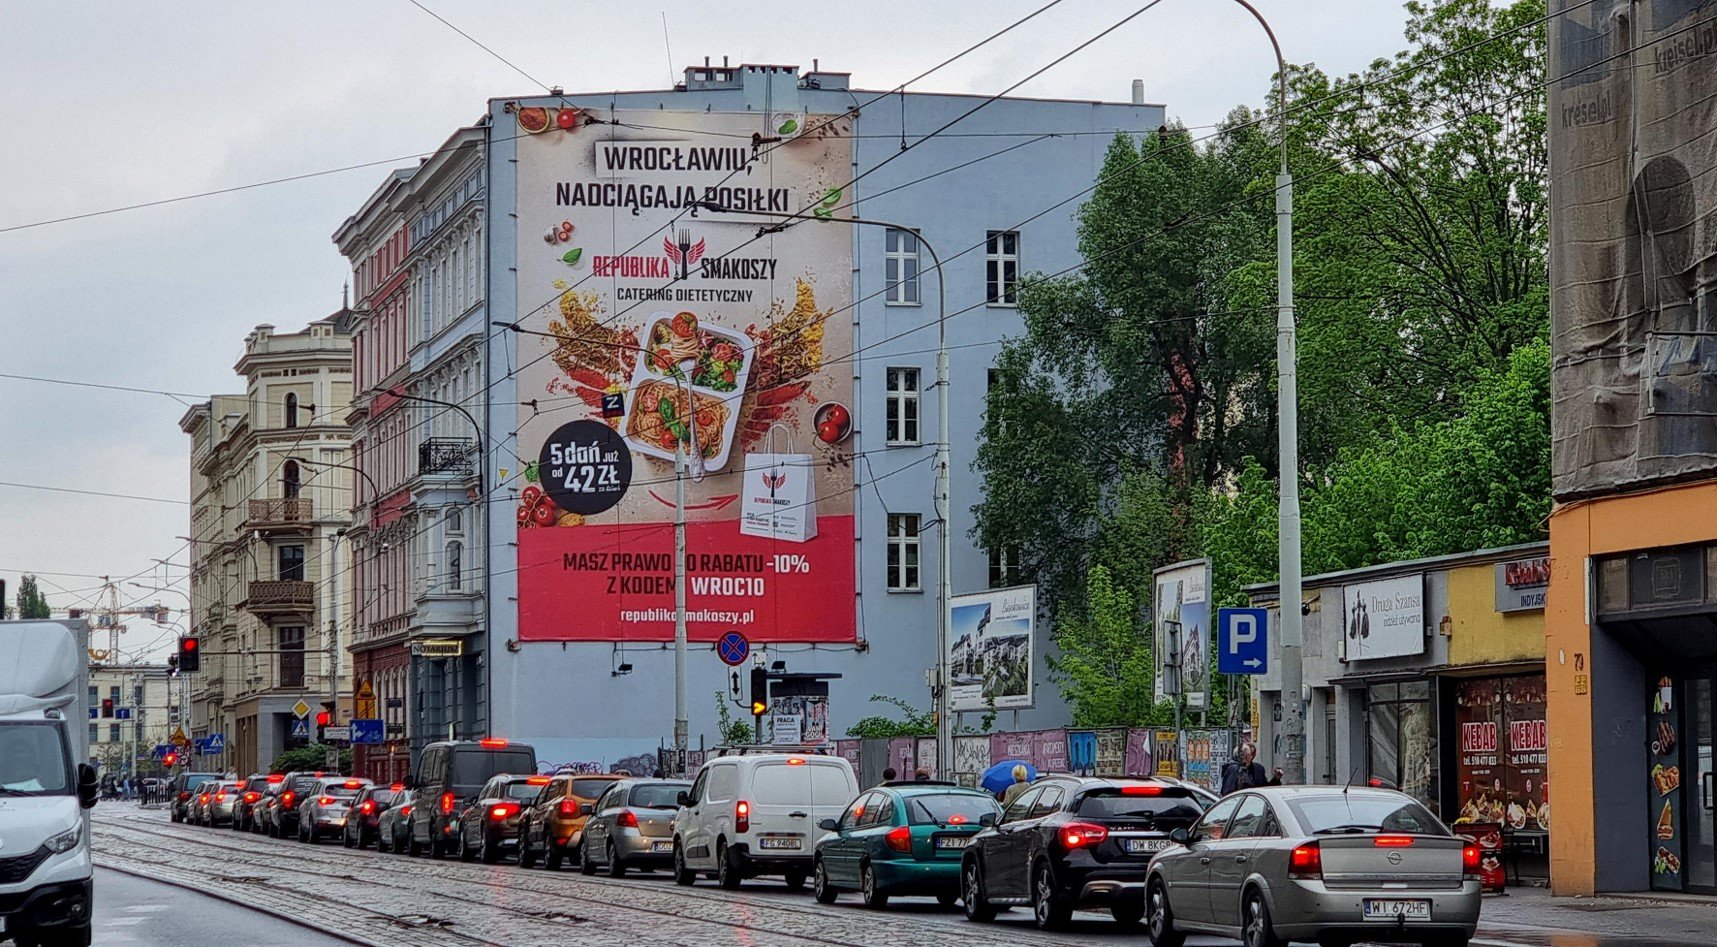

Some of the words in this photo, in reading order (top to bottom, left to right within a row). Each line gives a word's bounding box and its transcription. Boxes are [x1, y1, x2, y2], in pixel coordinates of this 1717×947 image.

[604, 146, 753, 176] WROCŁAWIU,
[556, 182, 698, 217] NADCIĄGAJĄ
[705, 186, 789, 212] POSIŁKI
[593, 255, 670, 278] REPUBLIKA
[701, 258, 777, 280] SMAKOSZY
[617, 287, 672, 301] CATERING
[676, 288, 753, 303] DIETETYCZNY
[550, 443, 563, 465] 5
[564, 440, 600, 464] dań
[602, 450, 619, 463] JUŻ
[551, 466, 563, 478] od
[564, 465, 596, 493] 42
[597, 464, 620, 485] ZŁ
[563, 553, 608, 571] MASZ
[611, 552, 671, 572] PRAWO
[681, 553, 696, 572] O
[700, 553, 764, 573] RABATU
[766, 554, 810, 574] -10%
[607, 576, 617, 595] Z
[620, 576, 676, 595] KODEM
[691, 577, 765, 596] WROC10
[1371, 595, 1393, 613] Druga
[1395, 592, 1421, 610] Szansa
[620, 608, 754, 624] republikamakoszy.pl
[1229, 613, 1257, 654] P
[1462, 722, 1497, 751] KEBAB
[1510, 720, 1547, 751] KEBAB
[1463, 756, 1471, 765] tel.
[1512, 755, 1520, 764] tel.
[1132, 840, 1145, 850] DW
[1372, 902, 1386, 913] WI
[1392, 902, 1426, 914] 672HF
